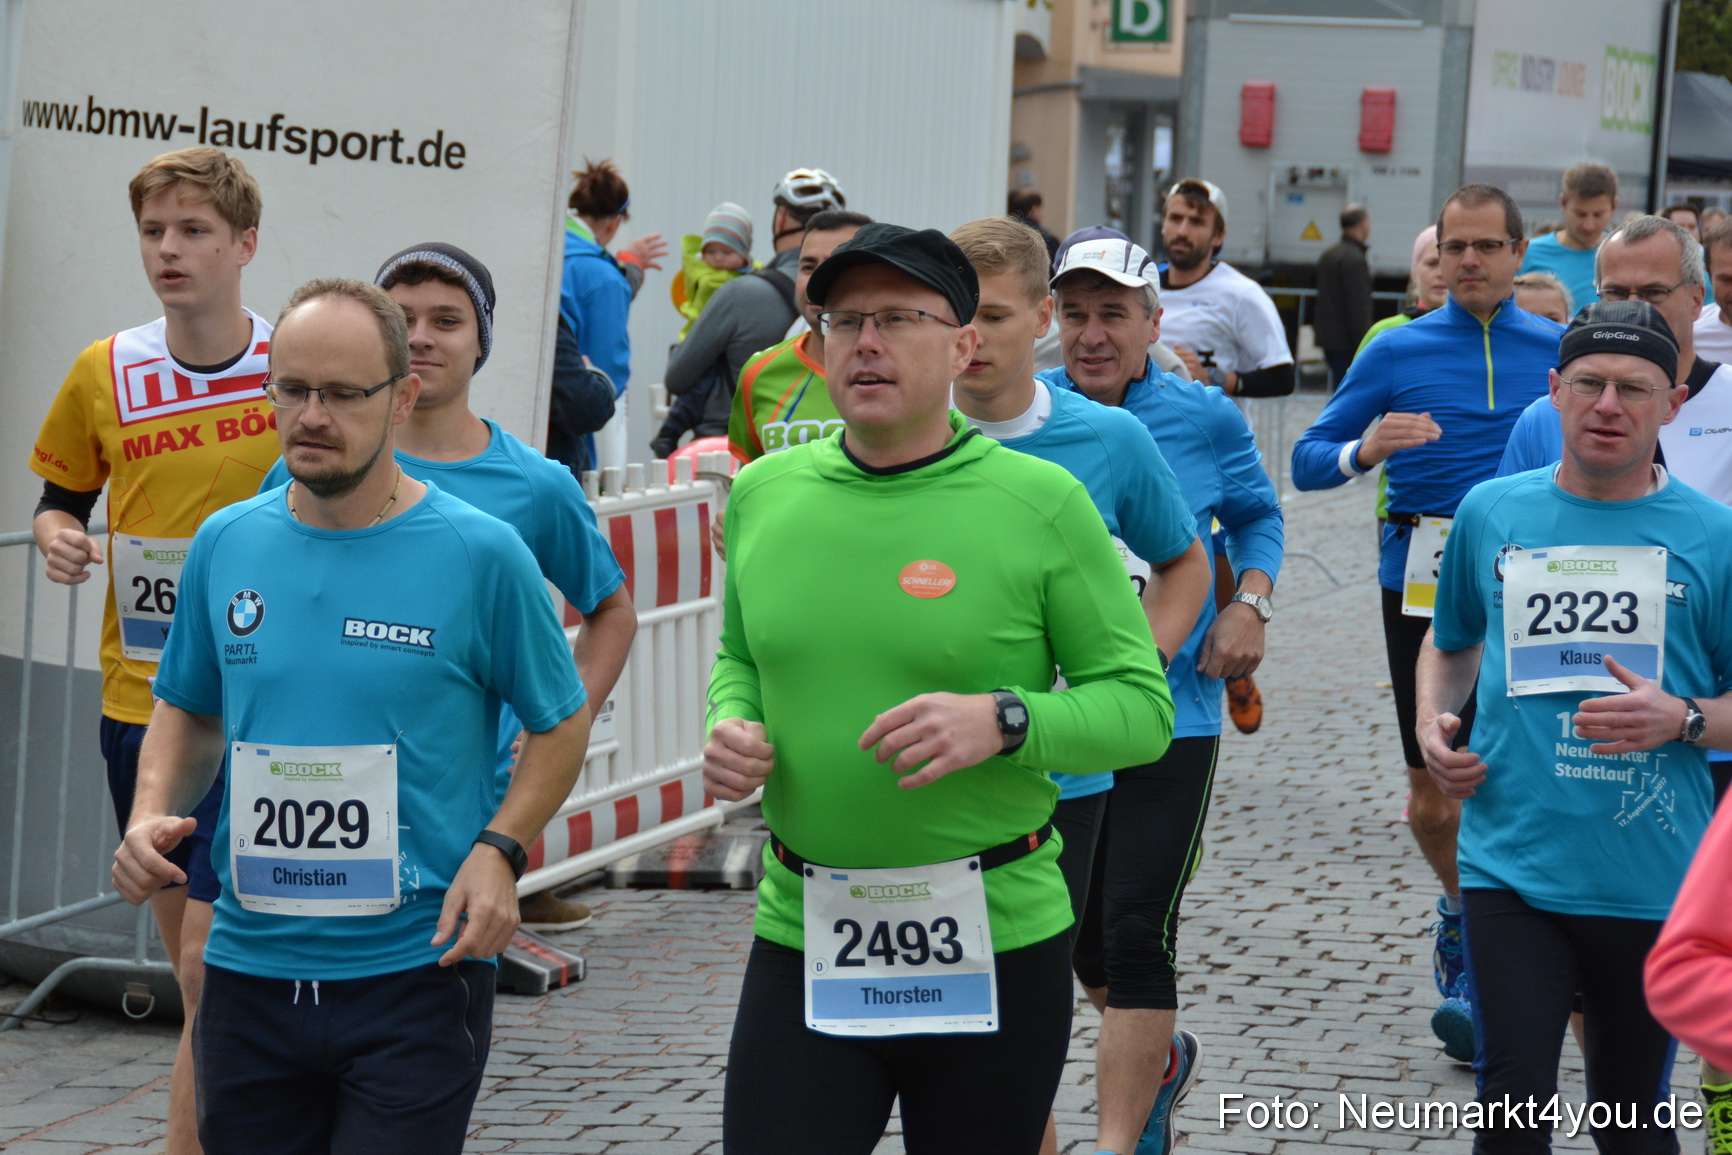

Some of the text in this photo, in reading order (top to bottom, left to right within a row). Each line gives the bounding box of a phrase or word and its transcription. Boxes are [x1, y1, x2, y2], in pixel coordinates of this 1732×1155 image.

[22, 95, 467, 171] www.bmw-laufsport.de
[1592, 331, 1640, 341] GripGrab
[121, 424, 205, 462] MAX
[1561, 560, 1618, 572] BOCK
[231, 591, 263, 606] BMW
[1526, 590, 1639, 637] 2323
[343, 618, 436, 648] BOCK
[1513, 632, 1519, 641] D
[224, 643, 258, 656] PARTL
[340, 638, 436, 657] inspired by smart concepts
[225, 656, 257, 665] Neumarkt
[1560, 650, 1602, 666] Klaus
[284, 762, 343, 777] BOCK
[1555, 763, 1636, 785] Stadtlauf
[253, 796, 370, 850] 2029
[239, 838, 245, 848] D
[272, 866, 347, 886] Christian
[867, 882, 932, 899] BOCK
[833, 915, 964, 968] 2493
[816, 962, 823, 971] D
[860, 985, 942, 1006] Thorsten
